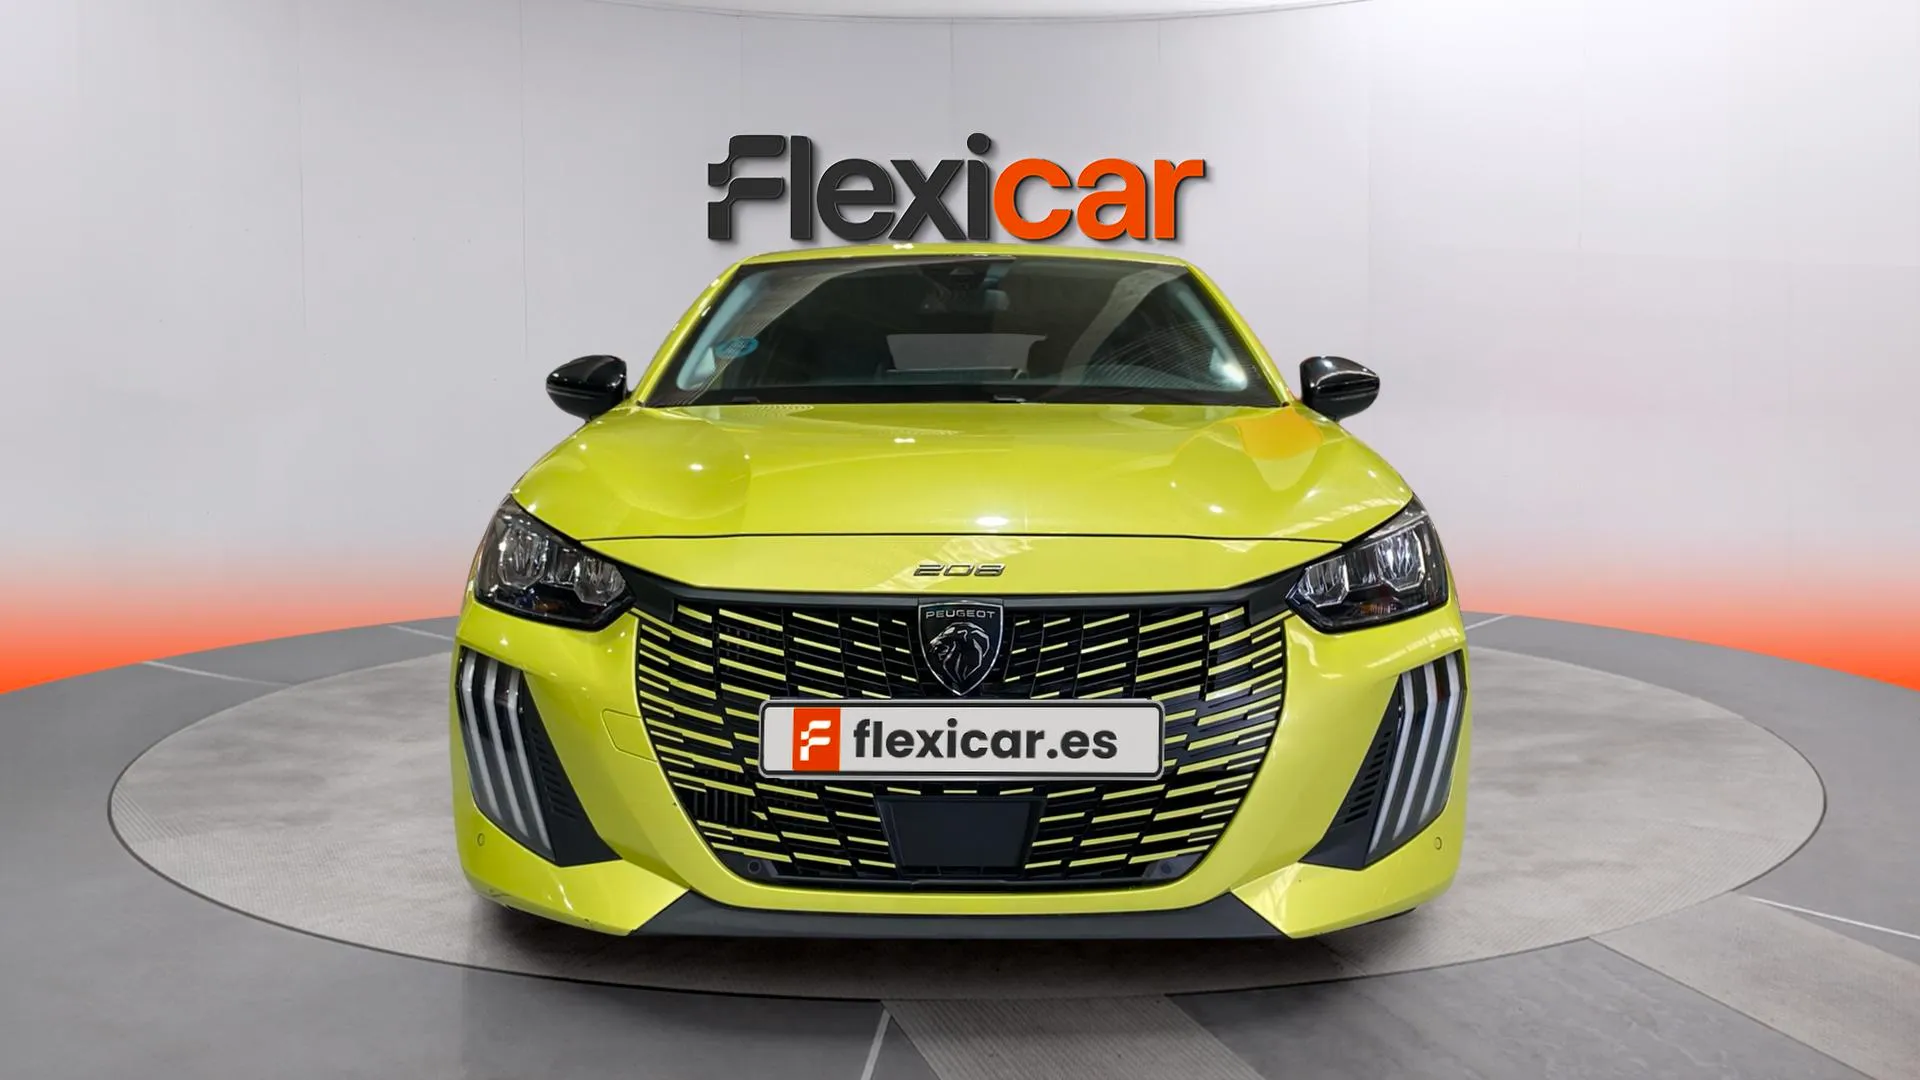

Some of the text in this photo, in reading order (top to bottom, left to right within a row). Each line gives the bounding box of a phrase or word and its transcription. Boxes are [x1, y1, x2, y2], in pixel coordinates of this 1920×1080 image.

[708, 133, 1205, 241] Flexicar
[913, 563, 1006, 577] 208
[925, 609, 996, 619] PEUGEOT
[853, 718, 1118, 759] flexicar.es
